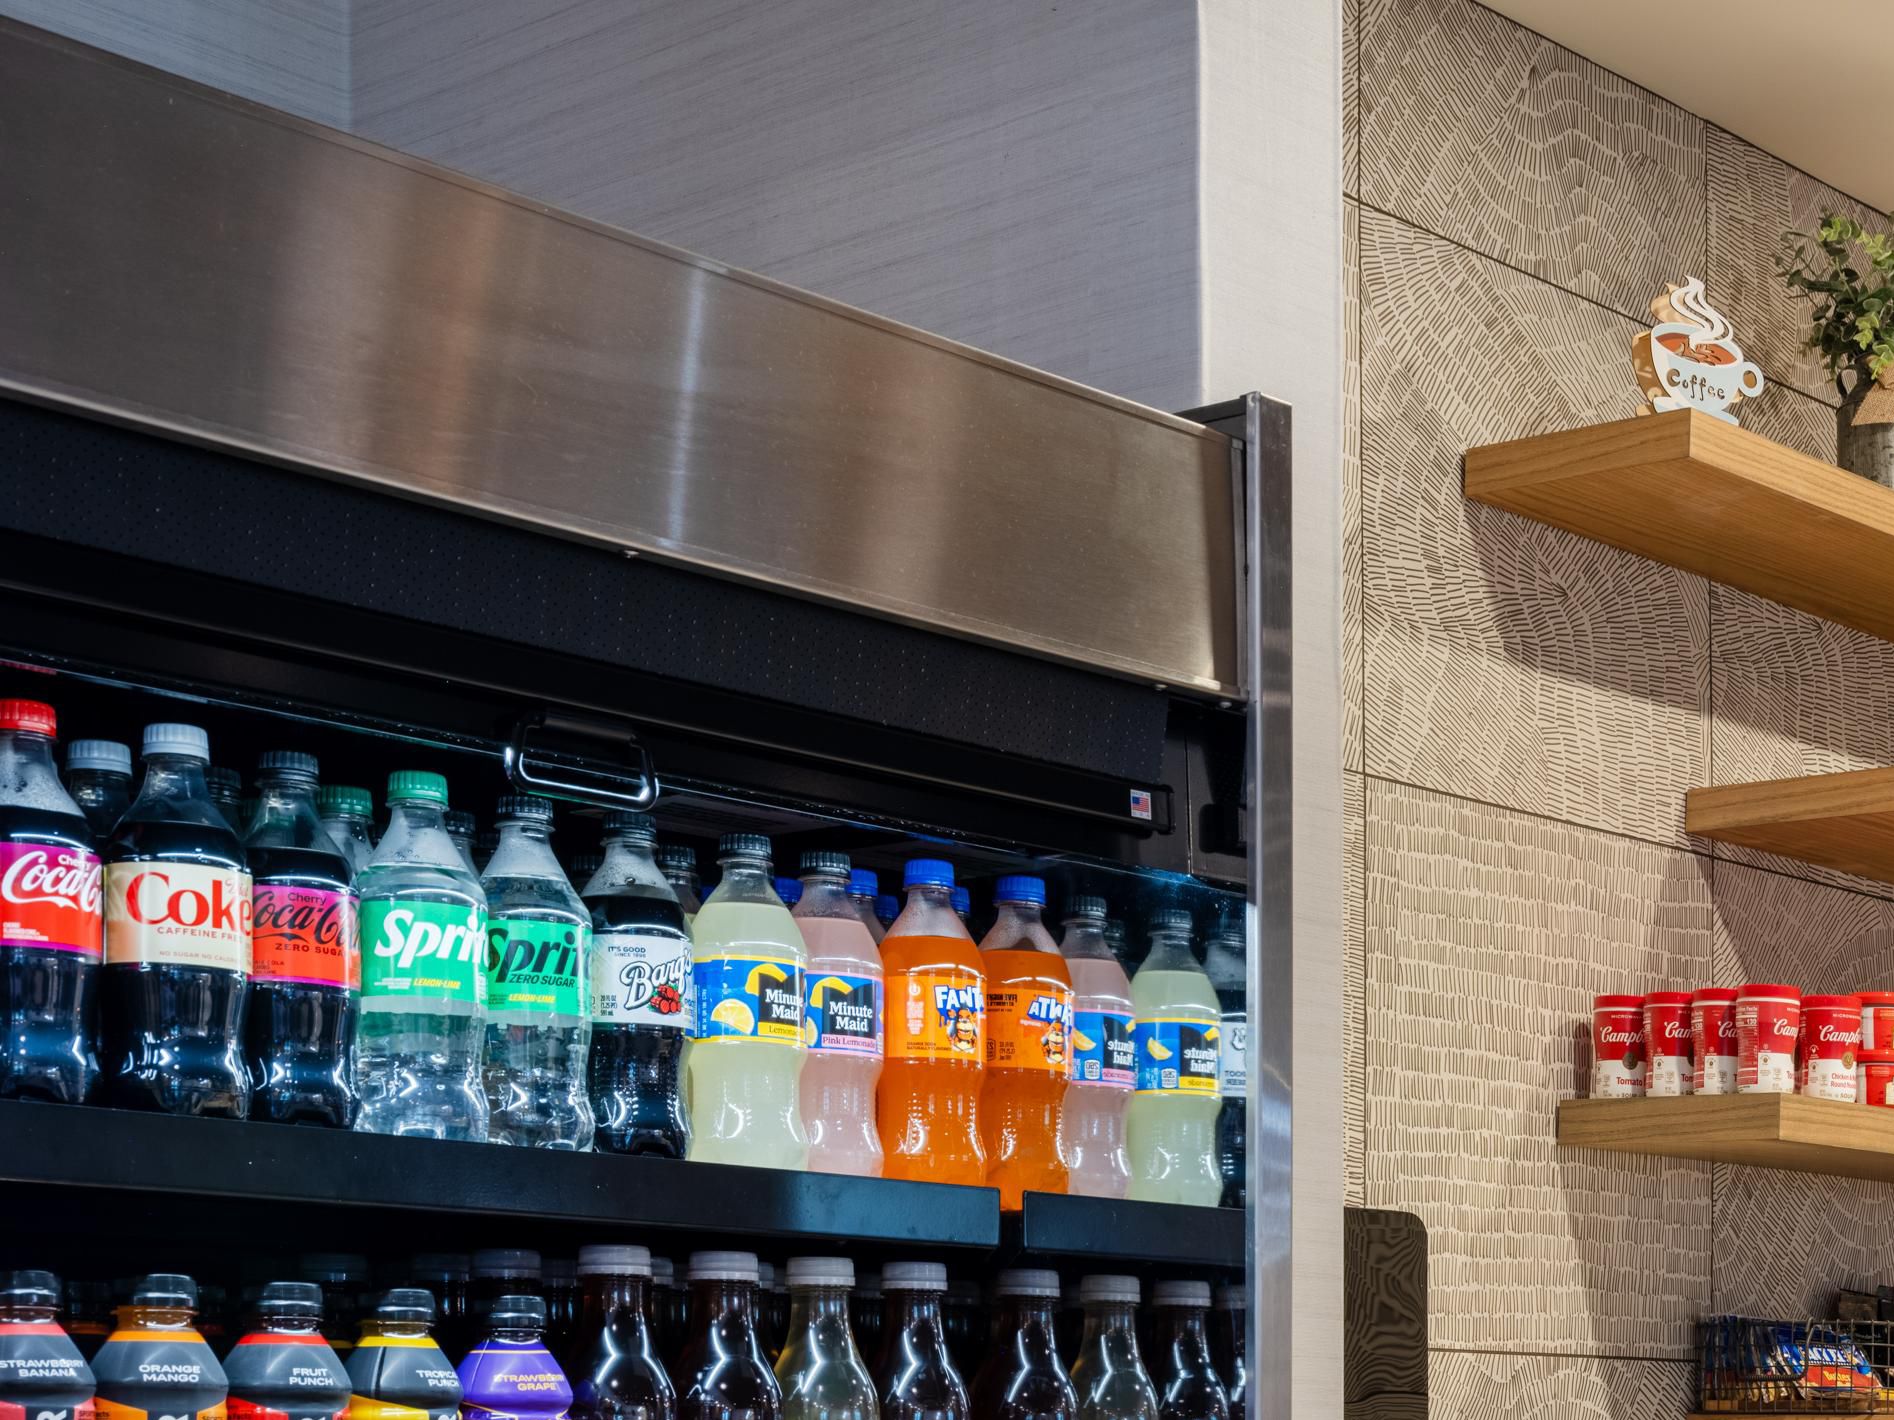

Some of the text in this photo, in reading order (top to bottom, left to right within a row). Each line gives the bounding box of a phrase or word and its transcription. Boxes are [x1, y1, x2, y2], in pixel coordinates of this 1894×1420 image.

[1666, 369, 1726, 402] Coffee
[126, 872, 251, 937] Coke
[157, 926, 217, 939] CAFFEINE
[829, 1001, 873, 1019] Minute
[835, 1018, 869, 1032] Maid
[1616, 1077, 1643, 1086] Tomato
[18, 1368, 77, 1378] BANANA
[139, 1365, 201, 1374] ORANGE
[292, 1367, 328, 1377] FRUIT
[143, 1373, 199, 1383] MANGO
[289, 1376, 334, 1386] PUNCH
[517, 1382, 557, 1391] GRAPE
